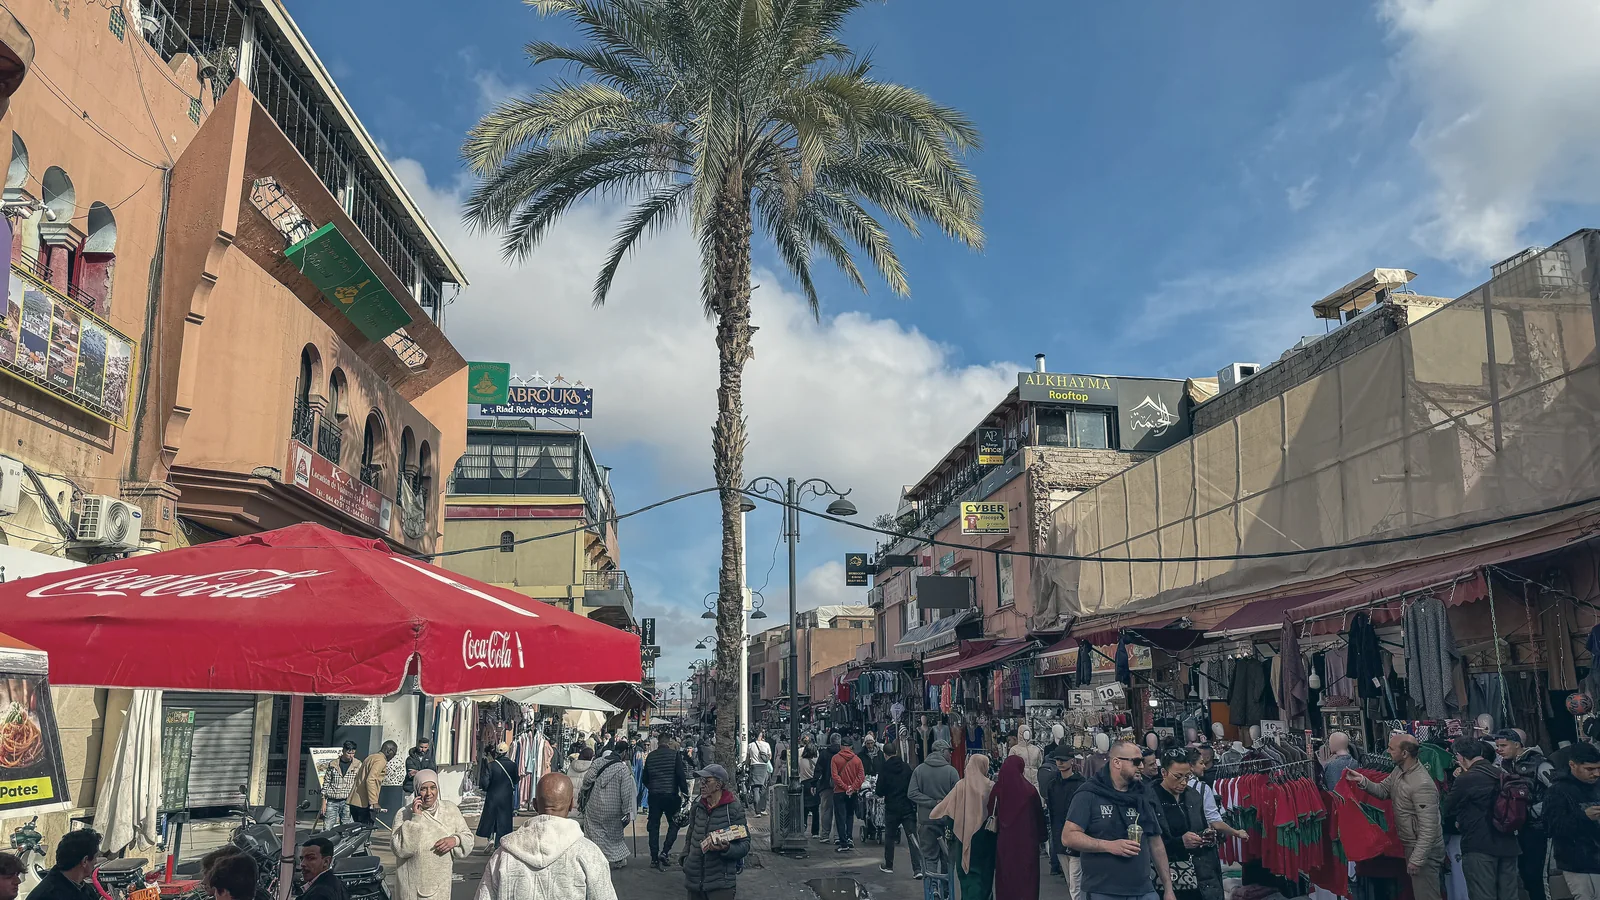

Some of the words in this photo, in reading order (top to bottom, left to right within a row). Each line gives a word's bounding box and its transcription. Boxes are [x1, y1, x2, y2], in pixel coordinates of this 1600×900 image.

[1024, 374, 1112, 390] ALKHAYMA
[508, 388, 581, 405] ABROUKA
[1049, 390, 1089, 403] Rooftop
[331, 466, 369, 499] K.A.T.
[339, 494, 351, 506] Rent
[355, 503, 364, 512] Car
[965, 504, 1005, 512] CYBER
[641, 648, 654, 656] KY
[641, 660, 653, 668] AR
[1073, 693, 1082, 704] 5
[1099, 688, 1114, 699] 10
[0, 785, 39, 798] Pates
